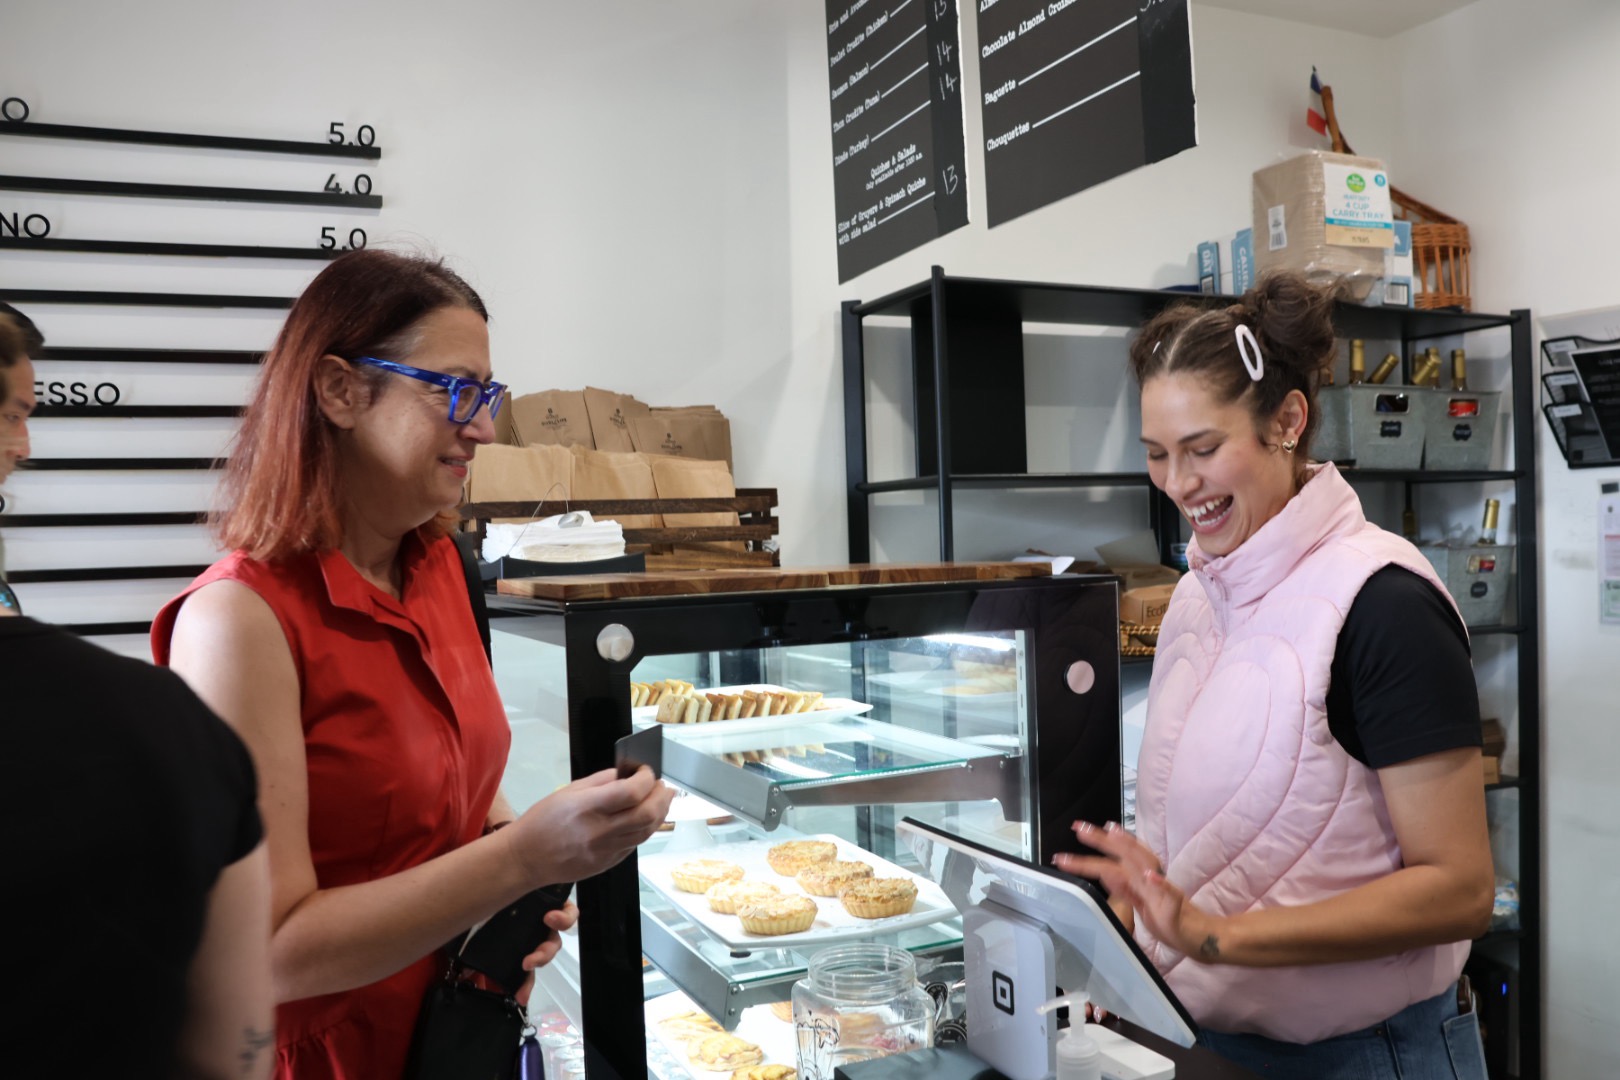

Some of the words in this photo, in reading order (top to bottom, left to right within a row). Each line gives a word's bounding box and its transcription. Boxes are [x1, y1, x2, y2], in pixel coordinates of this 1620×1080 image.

[840, 9, 849, 24] and
[982, 30, 1016, 58] Chocolate
[1018, 8, 1046, 36] Almond
[936, 40, 952, 66] 14
[849, 62, 869, 87] (Salmon)
[939, 72, 957, 101] 14
[985, 79, 1016, 105] Baguette
[328, 122, 375, 147] 5.0
[987, 122, 1030, 151] Chouquettes
[324, 173, 372, 196] 4.0
[943, 164, 958, 195] 13
[851, 214, 857, 226] of
[885, 187, 906, 208] Spinach
[907, 177, 926, 196] Quiche
[1332, 209, 1359, 218] CARRY
[1363, 211, 1385, 219] TRAY
[1353, 202, 1370, 210] CUP
[0, 212, 51, 239] NO
[321, 226, 367, 251] 5.0
